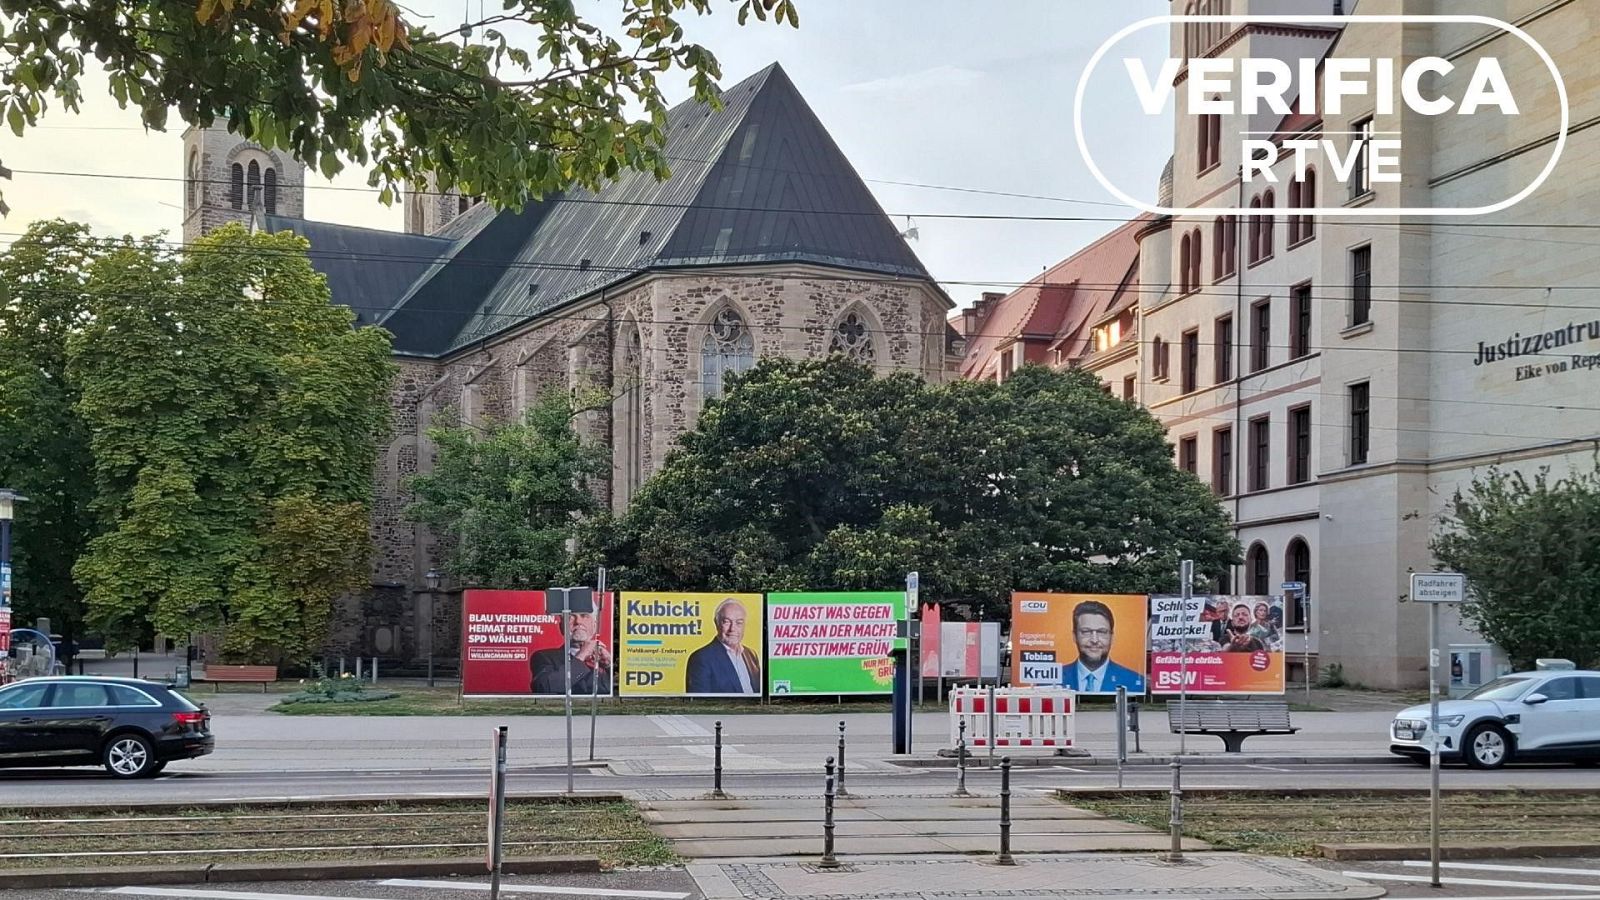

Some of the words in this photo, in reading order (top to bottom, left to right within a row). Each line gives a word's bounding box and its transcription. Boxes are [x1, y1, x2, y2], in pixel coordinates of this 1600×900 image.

[1474, 320, 1600, 366] Justizzentru
[1515, 365, 1542, 382] Eike
[1545, 361, 1567, 374] von
[1418, 579, 1457, 587] Radfahrer
[1419, 589, 1457, 598] absteigen
[626, 599, 700, 617] Kubicki
[773, 606, 791, 620] DU
[792, 606, 825, 619] HAST
[825, 605, 852, 619] WAS
[852, 605, 891, 619] GEGEN
[468, 614, 493, 623] BLAU
[494, 614, 559, 625] VERHINDERN,
[1163, 613, 1178, 623] mit
[468, 624, 506, 633] HEIMAT
[507, 625, 544, 635] RETTEN,
[626, 618, 703, 635] kommt!
[773, 624, 810, 638] NAZIS
[810, 624, 829, 638] AN
[829, 624, 852, 637] DER
[853, 623, 897, 637] MACHT:
[1156, 624, 1207, 636] Abzocke!
[468, 634, 487, 643] SPD
[488, 633, 533, 644] WÄHLEN!
[773, 642, 857, 656] ZWEITSTIMME
[857, 639, 890, 655] GRÜN
[1024, 651, 1054, 661] Tobias
[1155, 655, 1194, 664] Gefährlch
[1195, 655, 1224, 664] ehrlich.
[863, 660, 877, 669] NUR
[877, 658, 889, 668] MIT
[625, 671, 664, 686] FDP
[1023, 666, 1058, 679] Krull
[1159, 671, 1197, 685] BSW
